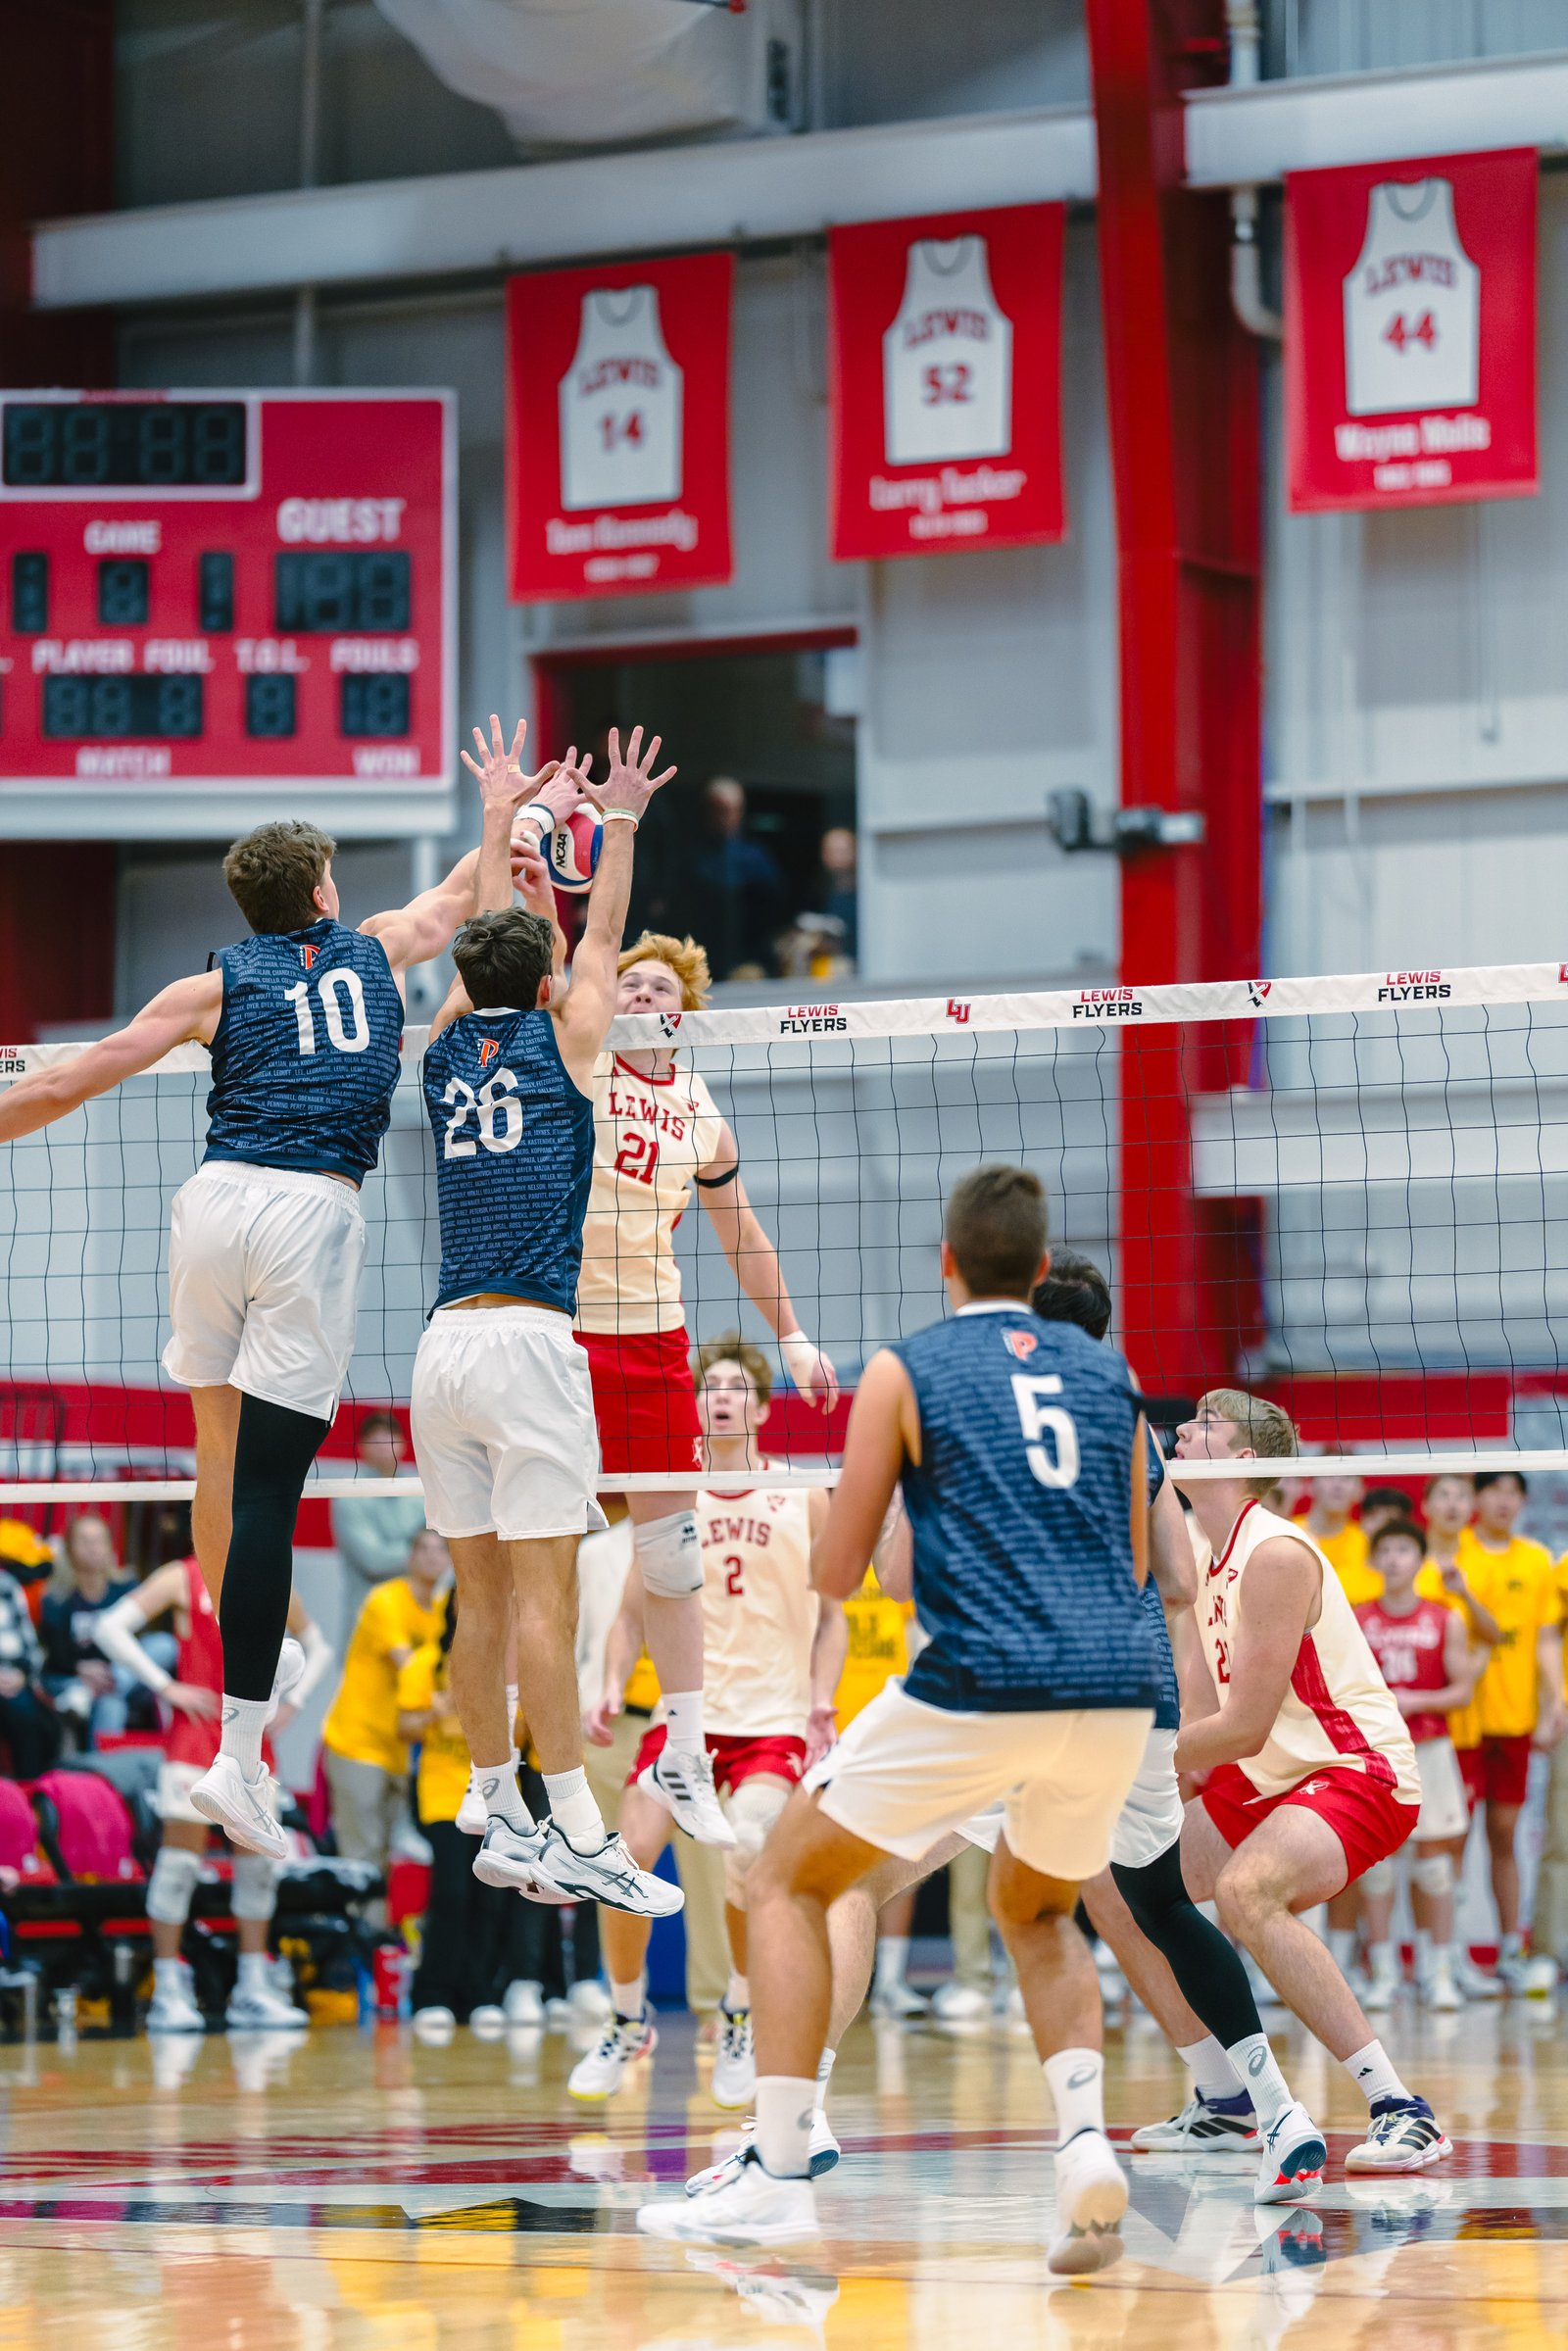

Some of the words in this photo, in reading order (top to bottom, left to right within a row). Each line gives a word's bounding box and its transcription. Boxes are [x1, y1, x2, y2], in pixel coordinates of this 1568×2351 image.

[1365, 253, 1456, 295] LEWIS
[906, 307, 991, 349] LEWIS
[1383, 309, 1438, 354] 44
[578, 355, 661, 397] LEWIS
[923, 364, 973, 405] 52
[600, 411, 644, 451] 14
[84, 520, 162, 555] GAME
[277, 497, 406, 543] GUEST
[32, 638, 133, 672] PLAYER
[556, 833, 567, 868] NCAA
[1081, 988, 1134, 1003] LEWIS
[1378, 984, 1451, 1002] FLYERS
[1385, 971, 1442, 985] LEWIS
[284, 967, 370, 1055] 10
[780, 1017, 848, 1034] FLYERS
[788, 1004, 839, 1018] LEWIS
[946, 998, 971, 1025] LU
[1073, 1003, 1143, 1018] FLYERS
[440, 1067, 523, 1159] 26
[609, 1092, 685, 1142] LEWIS
[613, 1132, 660, 1185] 21
[1010, 1373, 1081, 1489] 5
[723, 1554, 745, 1596] 2
